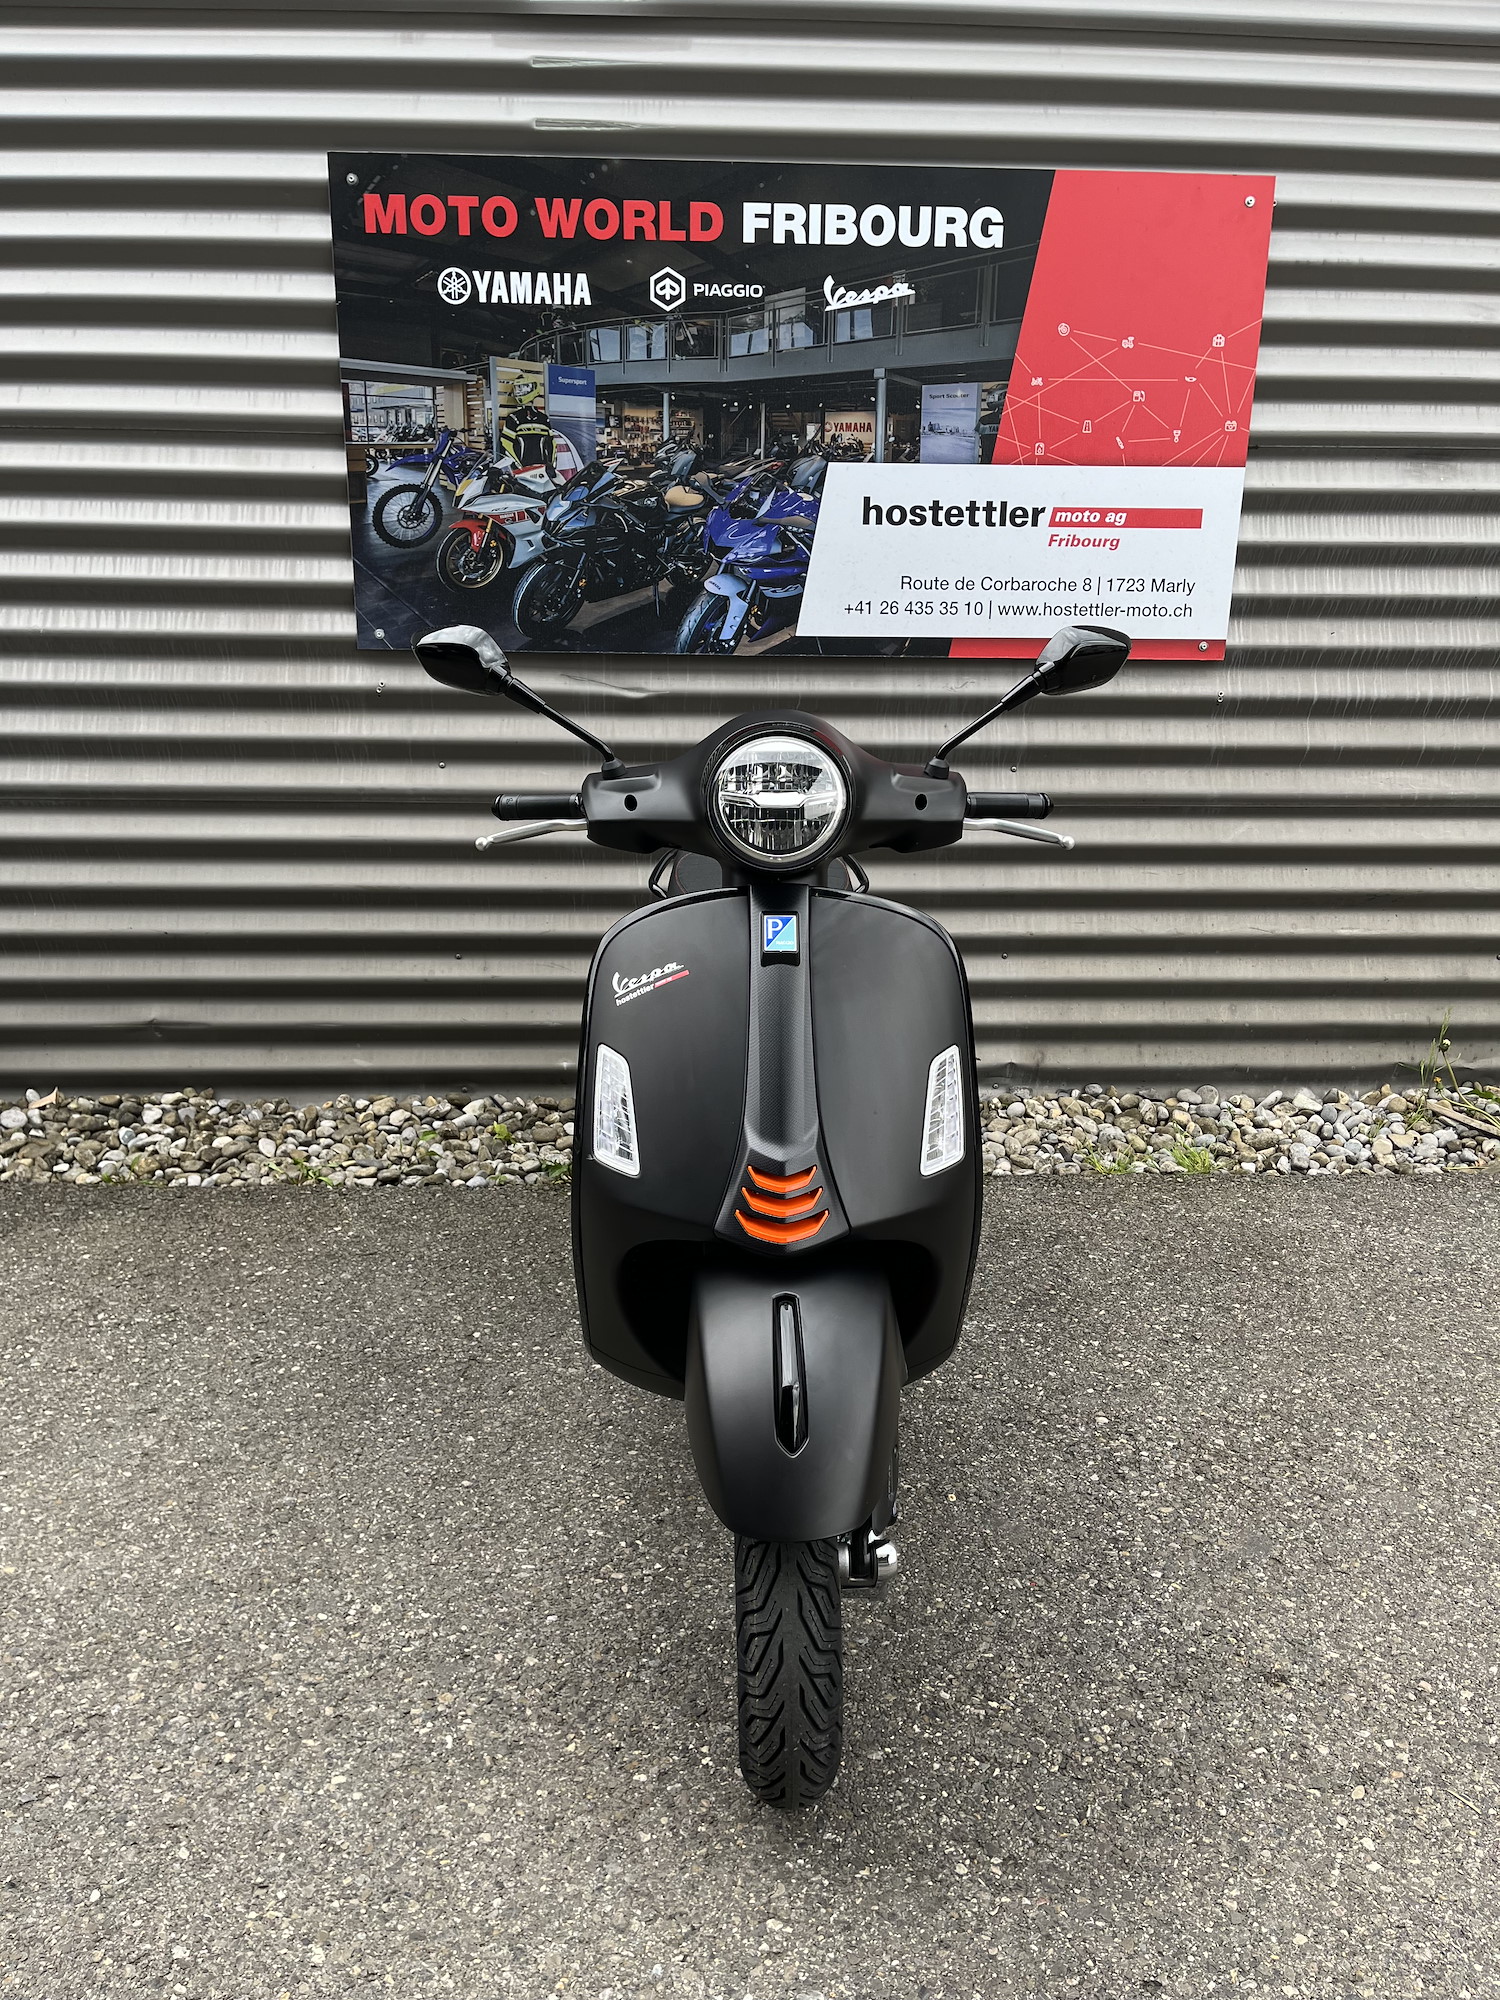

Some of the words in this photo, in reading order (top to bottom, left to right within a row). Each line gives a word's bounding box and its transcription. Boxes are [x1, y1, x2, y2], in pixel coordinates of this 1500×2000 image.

[363, 193, 518, 238] MOTO
[534, 197, 724, 243] WORLD
[742, 202, 1004, 249] FRIBOURG
[472, 270, 592, 306] YAMAHA
[693, 283, 763, 298] PIAGGIO
[824, 274, 916, 312] Vespa
[557, 376, 588, 386] Supersport
[833, 422, 872, 433] YAMAHA
[862, 496, 1047, 528] hostettler
[1055, 510, 1101, 523] moto
[1105, 511, 1127, 526] ag
[1048, 534, 1121, 551] Fribourg
[901, 576, 949, 590] Route
[955, 576, 975, 591] de
[981, 576, 1077, 592] Corbaroche
[1082, 577, 1092, 592] 8
[1106, 578, 1145, 592] 1723
[1151, 578, 1196, 597] Marly
[844, 600, 873, 615] +41
[879, 600, 899, 615] 26
[904, 601, 934, 615] 435
[939, 601, 959, 616] 35
[964, 601, 983, 616] 10
[997, 602, 1193, 618] www.hostettler-moto.ch
[767, 918, 784, 940] P
[612, 961, 685, 999] Vespa
[615, 983, 655, 1007] hostettler
